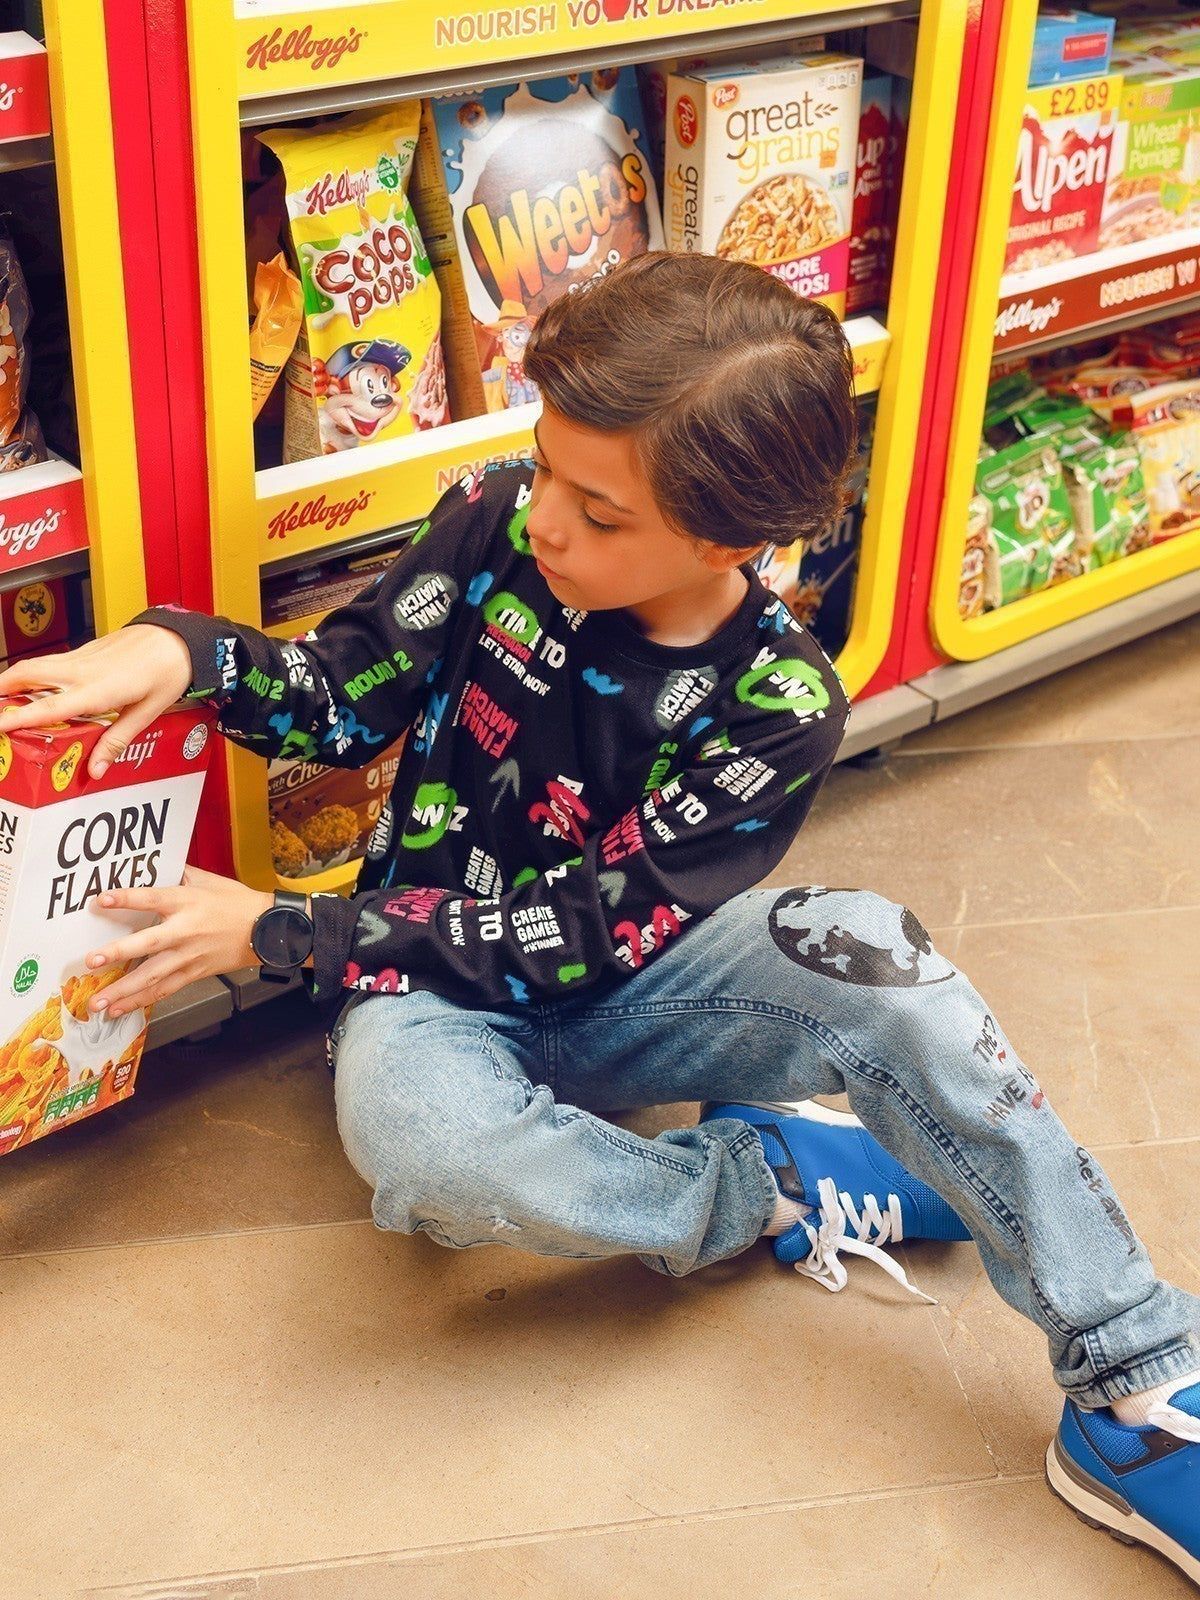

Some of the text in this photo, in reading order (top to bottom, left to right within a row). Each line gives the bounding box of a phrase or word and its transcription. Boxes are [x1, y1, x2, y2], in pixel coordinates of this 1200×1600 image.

[246, 25, 361, 70] Kellogg's
[435, 5, 557, 47] NOURISH
[713, 87, 739, 106] Post
[1050, 82, 1109, 117] £2.89
[726, 91, 814, 159] great
[737, 126, 840, 184] grains
[1012, 127, 1107, 213] Alpen
[306, 168, 370, 216] Kellogg's
[678, 164, 700, 241] great
[466, 153, 646, 302] Weetos
[771, 256, 821, 281] MORE
[1100, 264, 1175, 308] NOURISH
[348, 264, 414, 327] pops
[995, 298, 1062, 336] Kellogg's
[0, 508, 61, 556] ogg's
[267, 490, 372, 540] Kellogg's
[396, 575, 446, 618] MATCH
[407, 593, 451, 631] FINAL
[393, 650, 413, 672] 2
[478, 633, 504, 659] LET'S
[522, 673, 551, 697] NOW
[539, 636, 566, 669] TO
[269, 680, 285, 700] 2
[461, 702, 508, 758] FINAL
[466, 682, 519, 742] MATCH
[382, 757, 399, 774] HIG
[659, 742, 678, 755] 2
[726, 760, 768, 796] GAMES
[373, 806, 393, 853] FINAL
[675, 791, 708, 825] TO
[57, 798, 172, 870] CORN
[651, 818, 677, 843] NOW
[46, 849, 162, 921] FLAKES
[464, 846, 485, 890] CREATE
[476, 854, 497, 896] GAMES
[449, 917, 466, 946] NOW
[478, 911, 504, 941] TO
[511, 905, 556, 927] CREATE
[516, 919, 561, 943] GAMES
[522, 935, 565, 955] #WINNER
[982, 1079, 1027, 1129] HAVE
[1076, 1146, 1103, 1194] Get
